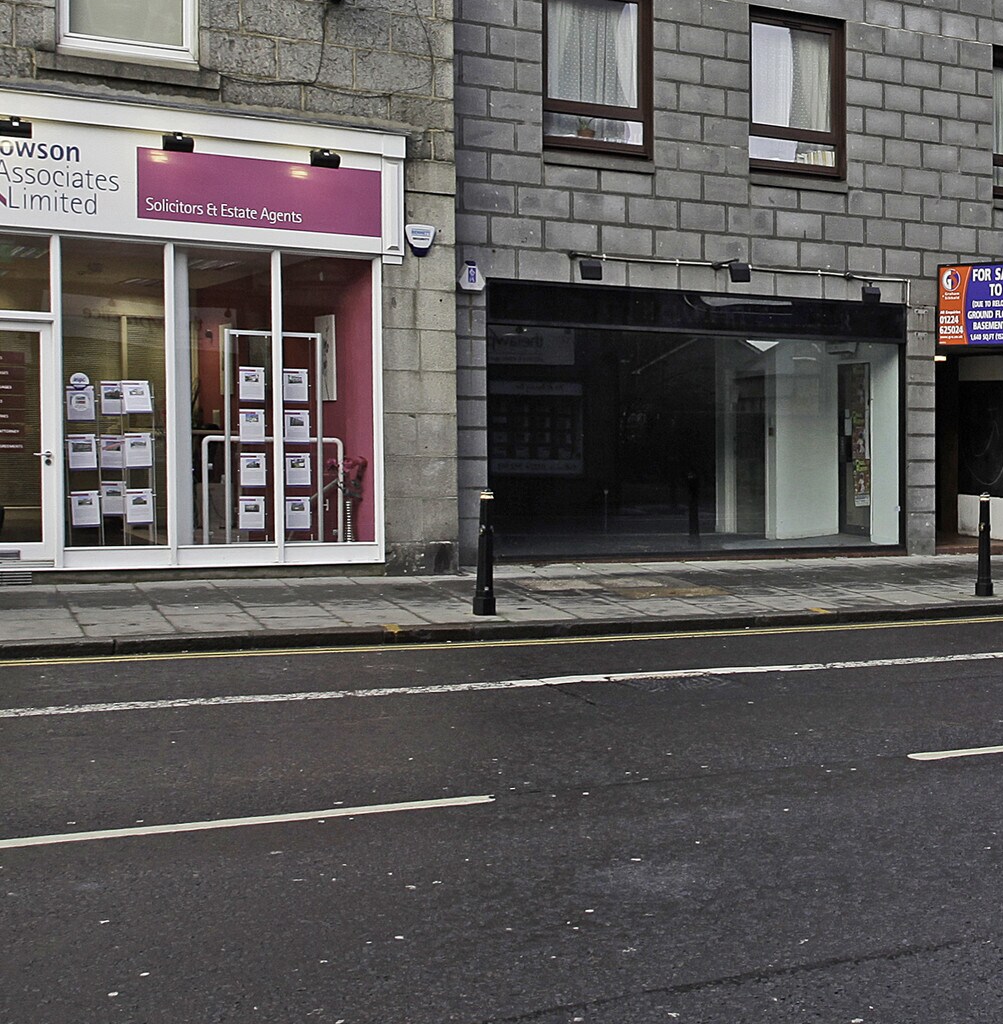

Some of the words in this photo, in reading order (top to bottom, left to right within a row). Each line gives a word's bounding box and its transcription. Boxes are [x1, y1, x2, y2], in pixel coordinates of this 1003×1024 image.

[0, 140, 80, 162] owson
[0, 159, 119, 191] Associates
[9, 186, 97, 214] Limited
[145, 197, 204, 215] Solicitors
[207, 203, 217, 217] &
[220, 203, 258, 220] Estate
[260, 207, 303, 224] Agents
[972, 268, 991, 282] FOR
[989, 283, 1002, 296] TO
[939, 315, 959, 324] 01224
[967, 310, 994, 319] GROUND
[939, 325, 964, 335] 625024
